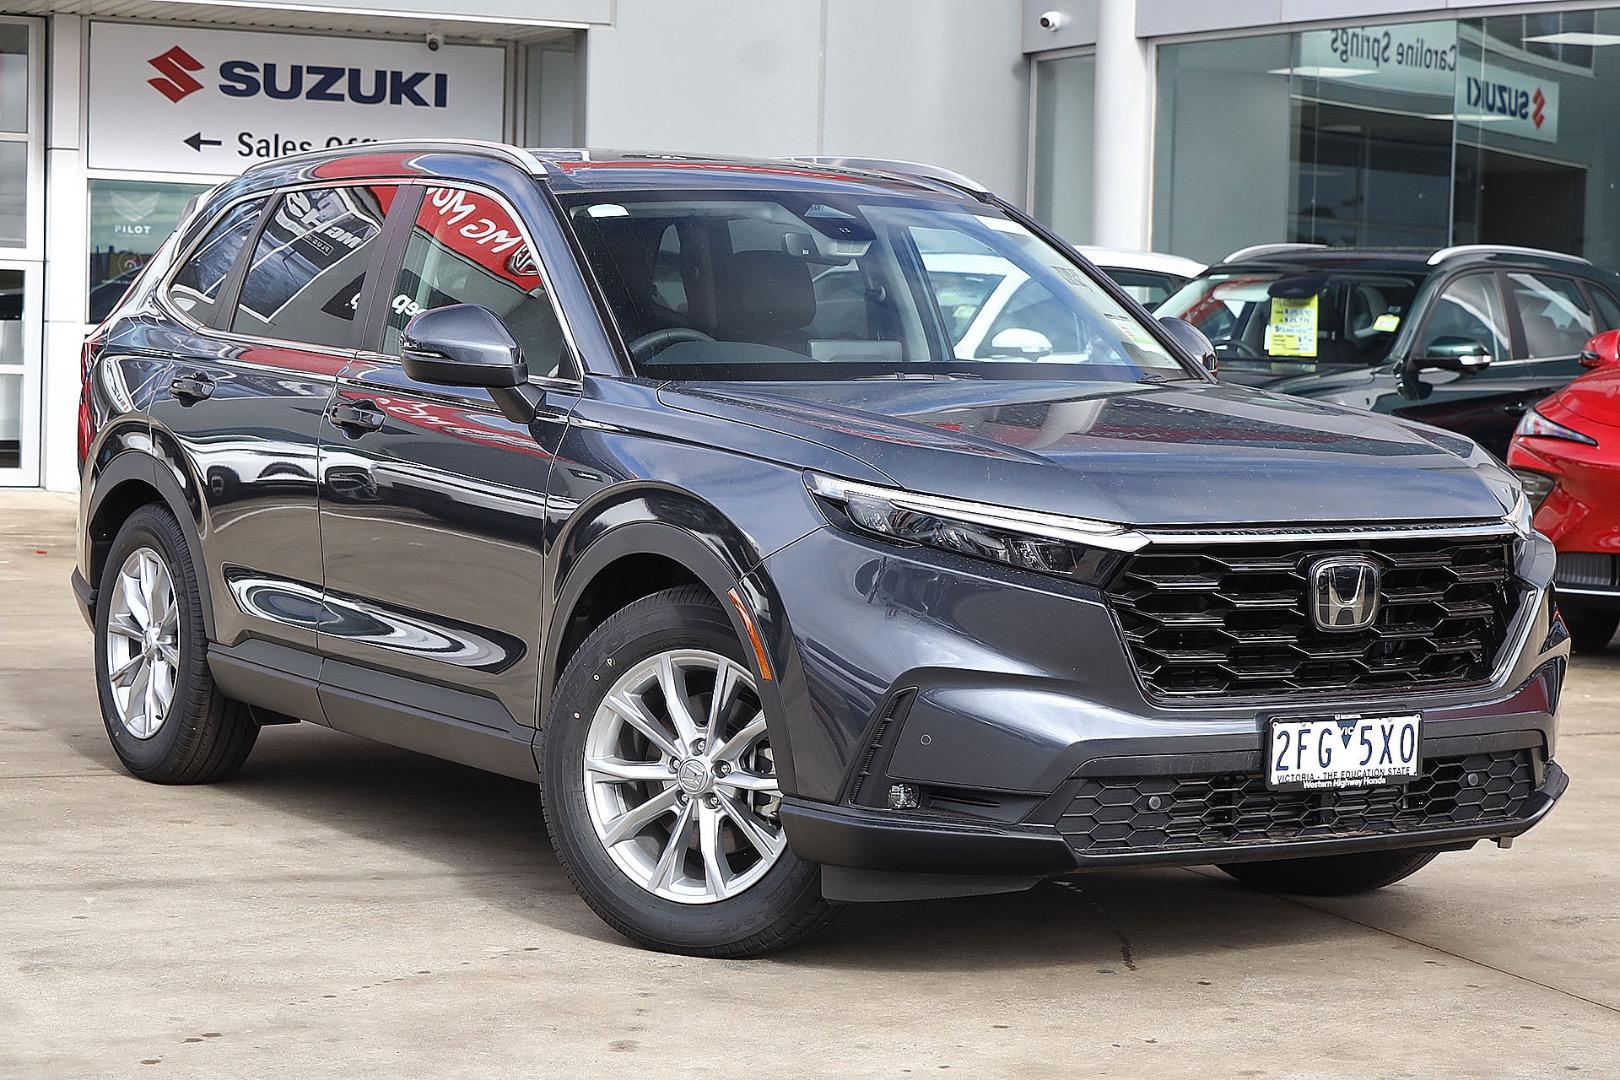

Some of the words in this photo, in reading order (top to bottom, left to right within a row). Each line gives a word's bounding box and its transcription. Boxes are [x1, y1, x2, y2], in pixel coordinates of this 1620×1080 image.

[219, 61, 447, 108] SUZUKI
[237, 132, 312, 158] Sales
[114, 225, 152, 234] PILOT
[1275, 728, 1333, 771] 2FG
[1277, 772, 1314, 783] VICTORIA
[1323, 771, 1338, 779] THE
[1341, 768, 1385, 779] EDUCATION
[1387, 766, 1411, 775] STATE
[1303, 779, 1332, 789] Western
[1333, 777, 1363, 789] Highway
[1363, 776, 1386, 785] Honda
